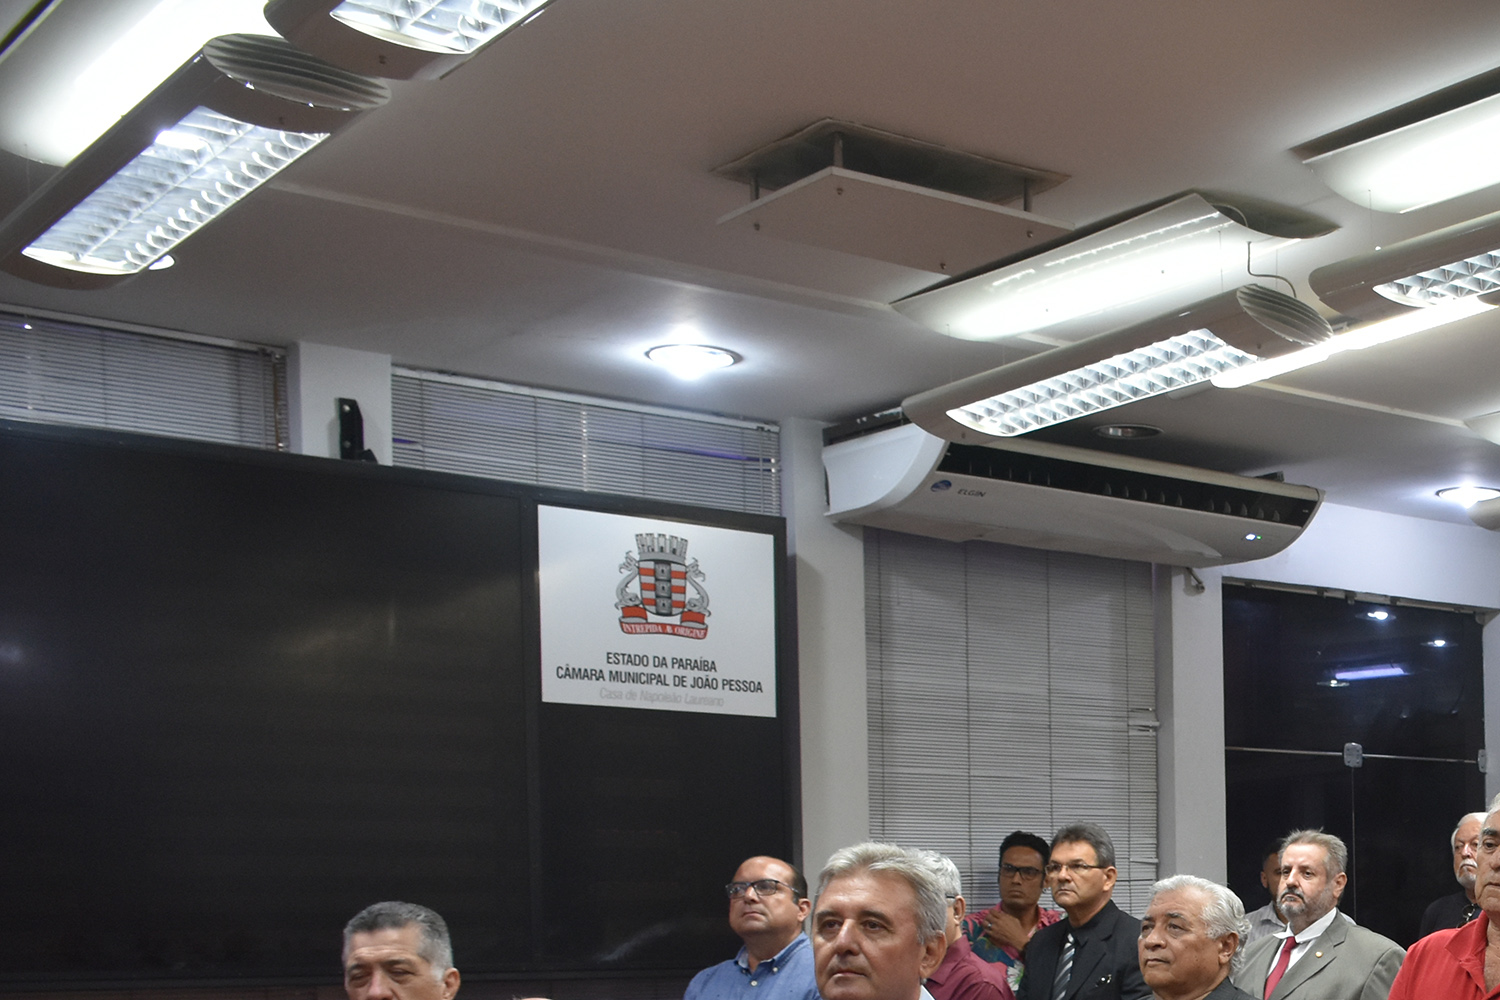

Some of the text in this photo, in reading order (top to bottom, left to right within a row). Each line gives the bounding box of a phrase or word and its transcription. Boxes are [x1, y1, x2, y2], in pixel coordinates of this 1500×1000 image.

[957, 489, 987, 497] ELGIN
[622, 623, 663, 633] INTREPIDA
[674, 627, 707, 638] ORIGINE
[606, 652, 717, 672] ESTADO DA PARAÍBA
[556, 664, 763, 692] CÂMARA MUNICIPAL DE JOÃO PESSOA
[600, 688, 623, 699] Casa
[625, 689, 637, 699] de
[684, 693, 725, 706] Laureano
